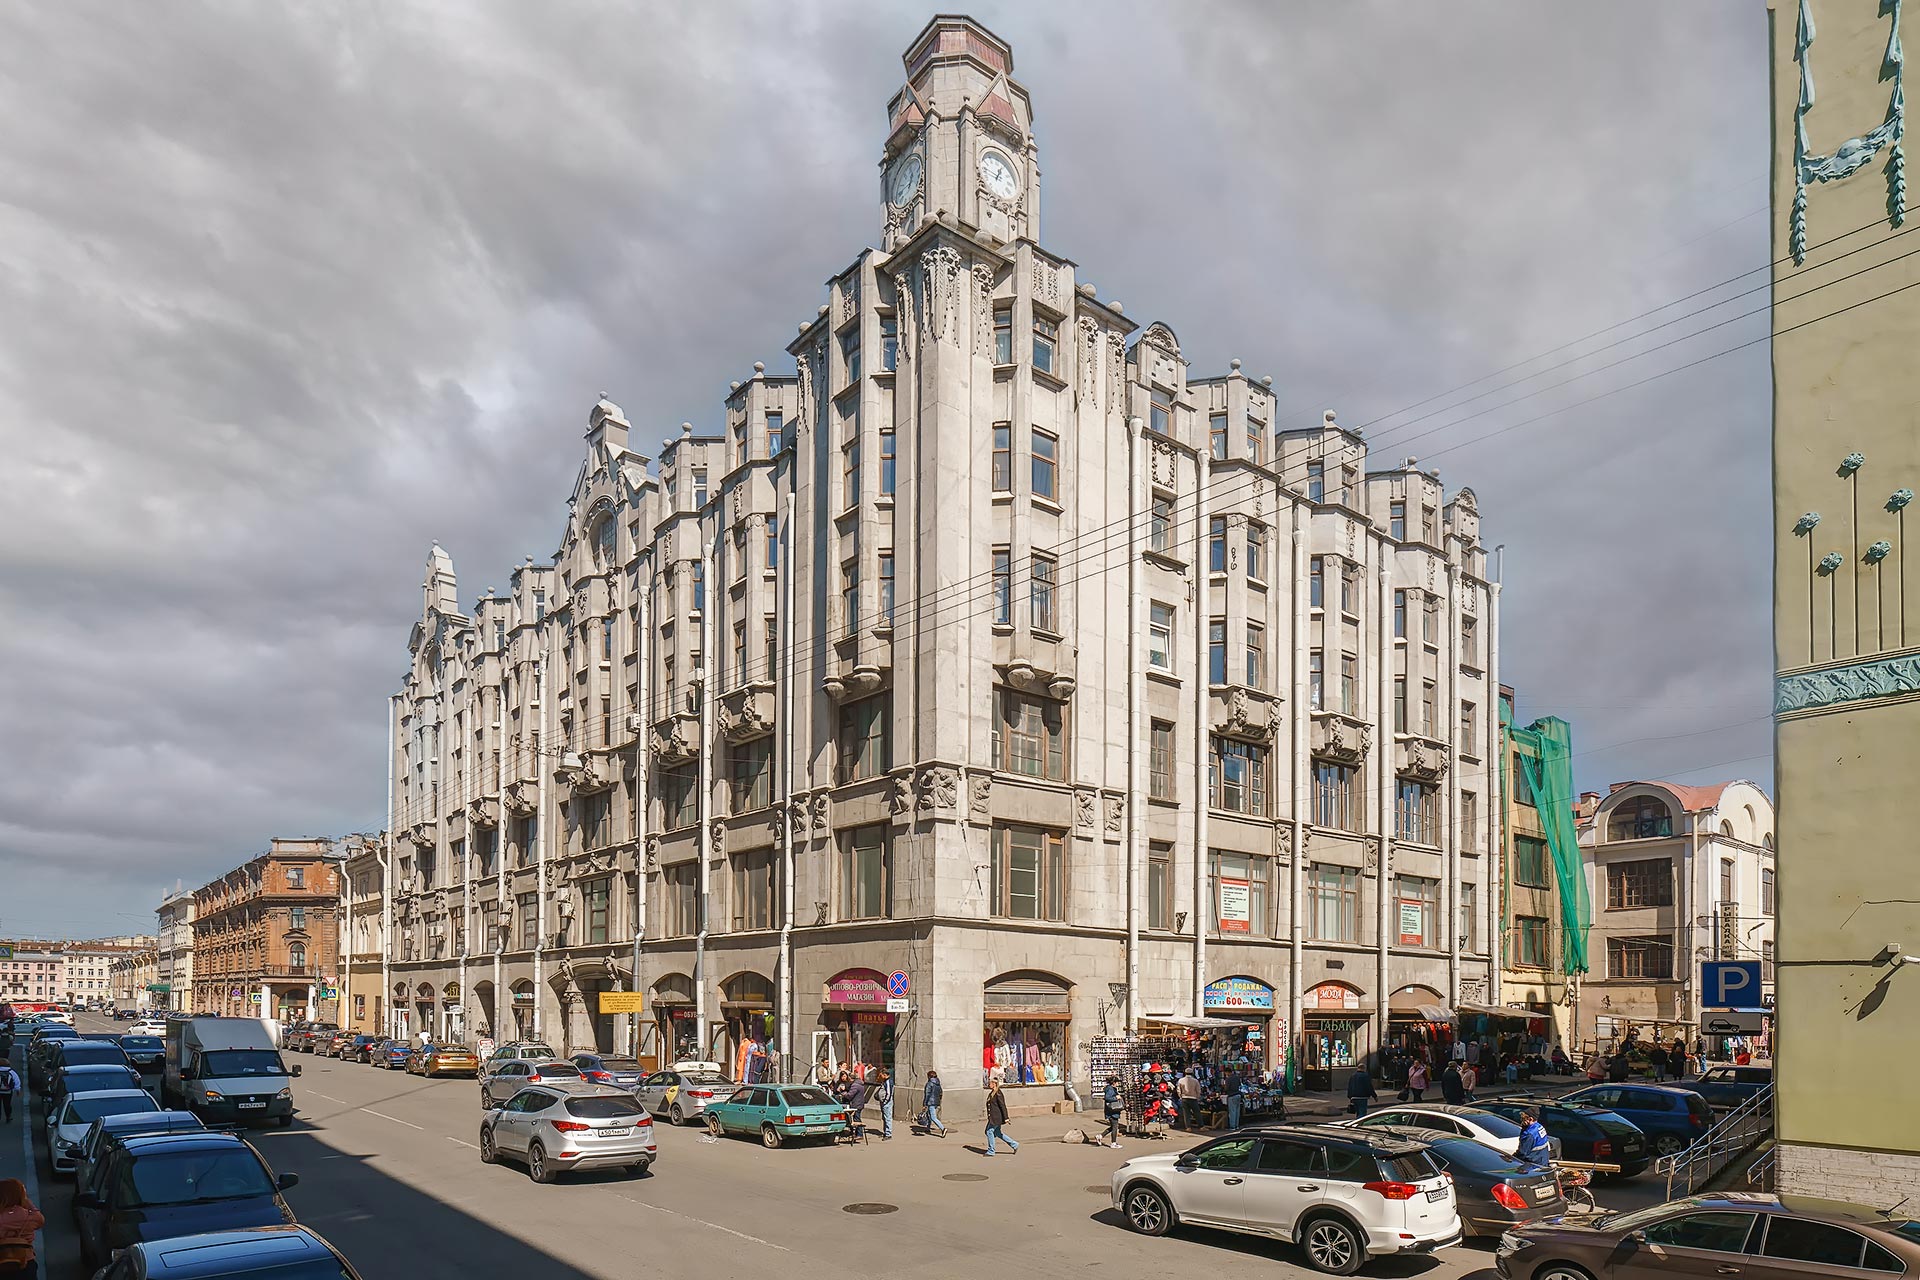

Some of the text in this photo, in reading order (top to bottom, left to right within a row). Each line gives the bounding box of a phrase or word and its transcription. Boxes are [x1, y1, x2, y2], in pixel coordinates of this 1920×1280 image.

[1718, 966, 1750, 1003] P
[846, 993, 875, 1001] МАГАЗИН
[1226, 996, 1242, 1005] 600
[857, 1013, 887, 1021] Платья
